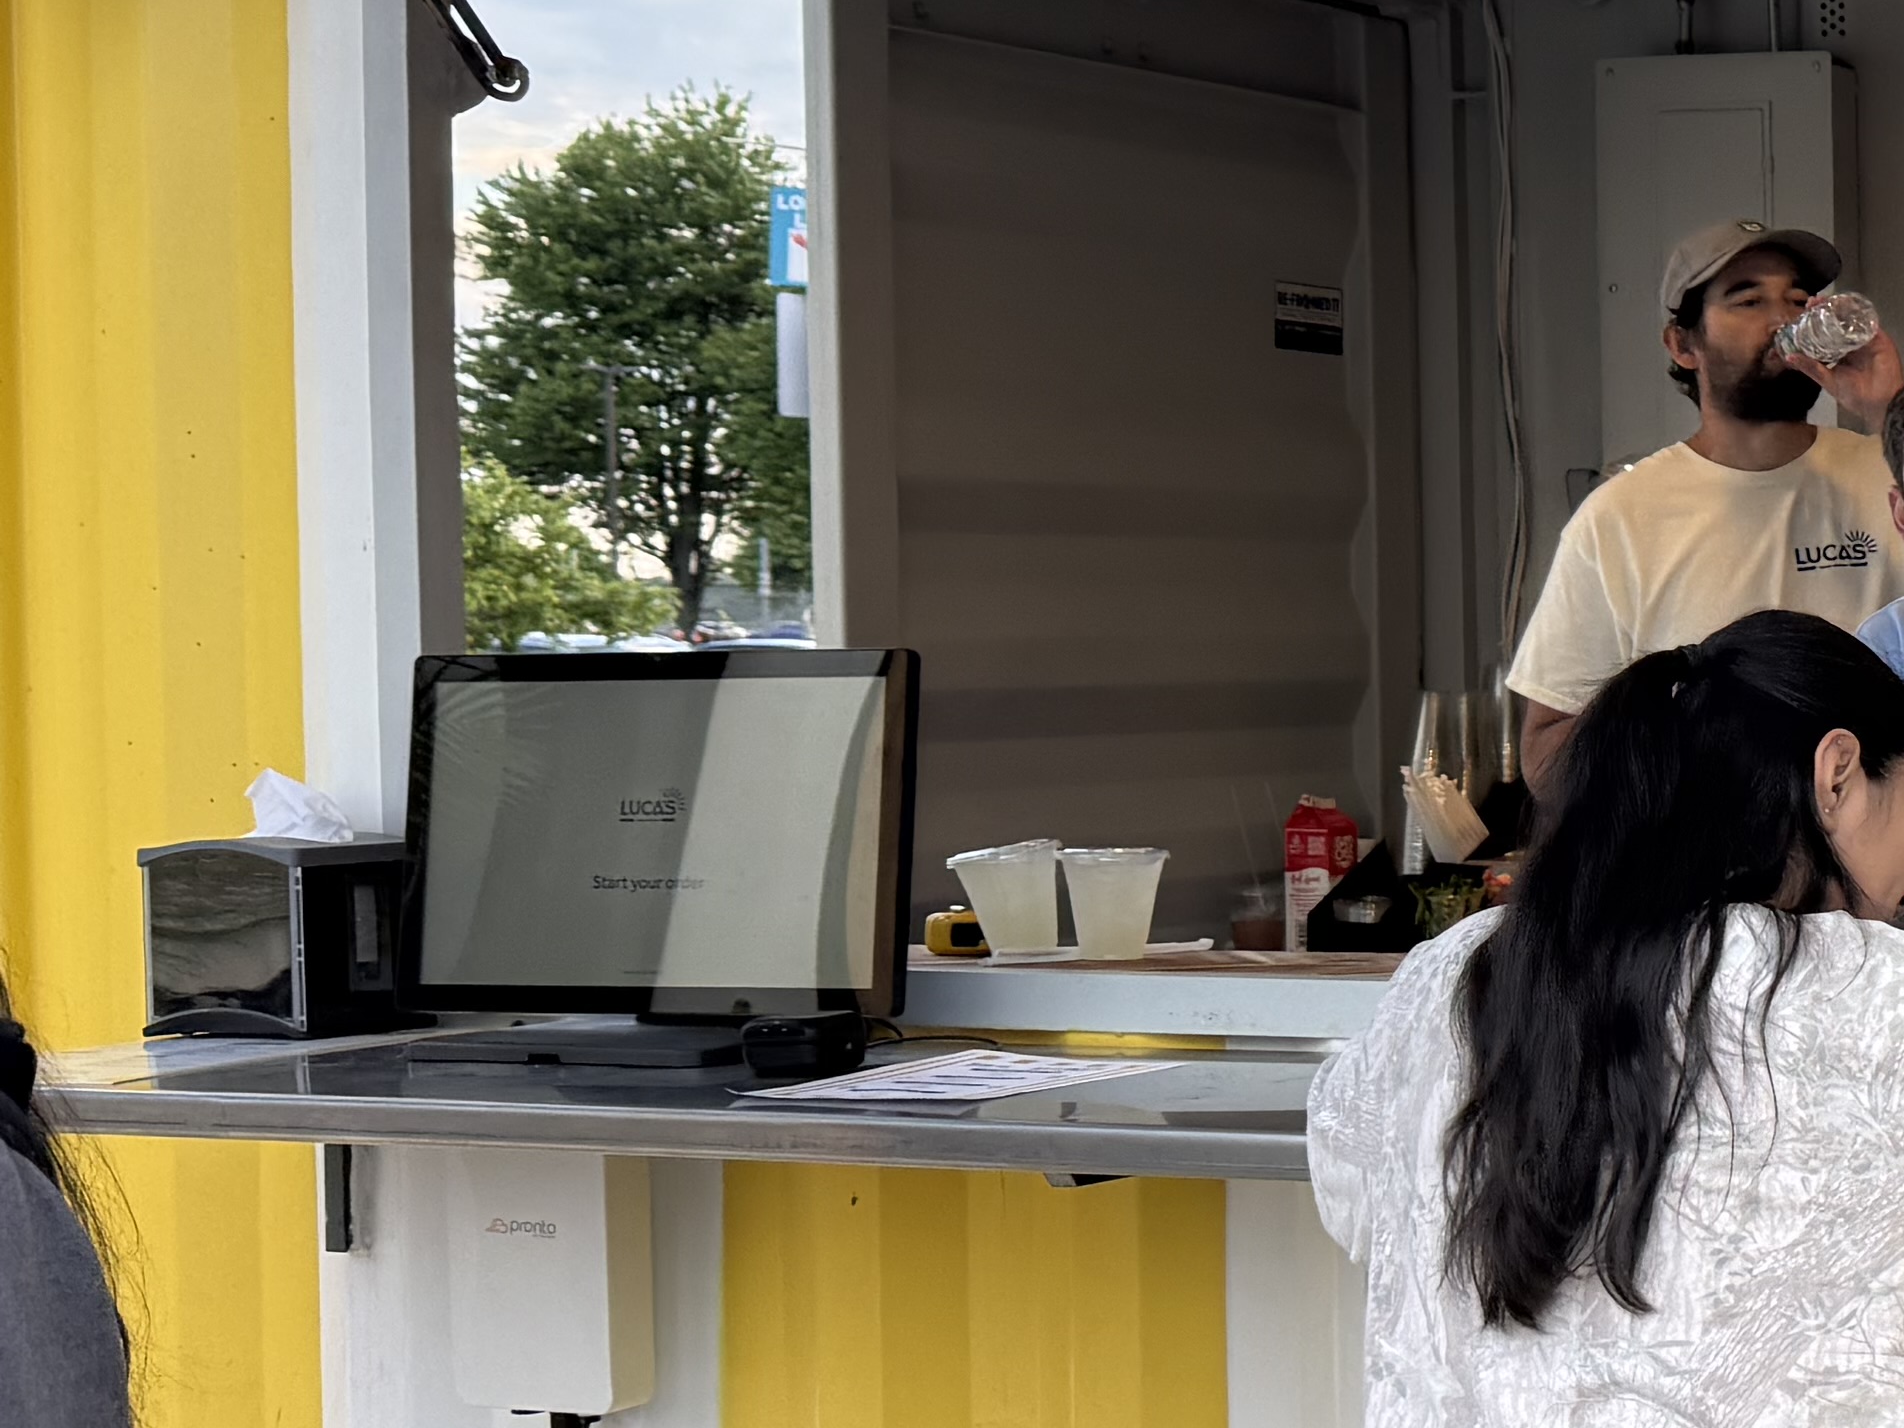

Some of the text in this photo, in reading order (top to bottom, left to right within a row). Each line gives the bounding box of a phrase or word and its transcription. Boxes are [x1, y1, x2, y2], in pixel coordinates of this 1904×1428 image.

[1795, 543, 1867, 564] LUCA'S
[593, 875, 628, 890] Start
[629, 877, 665, 893] your
[509, 1220, 557, 1236] pronto
